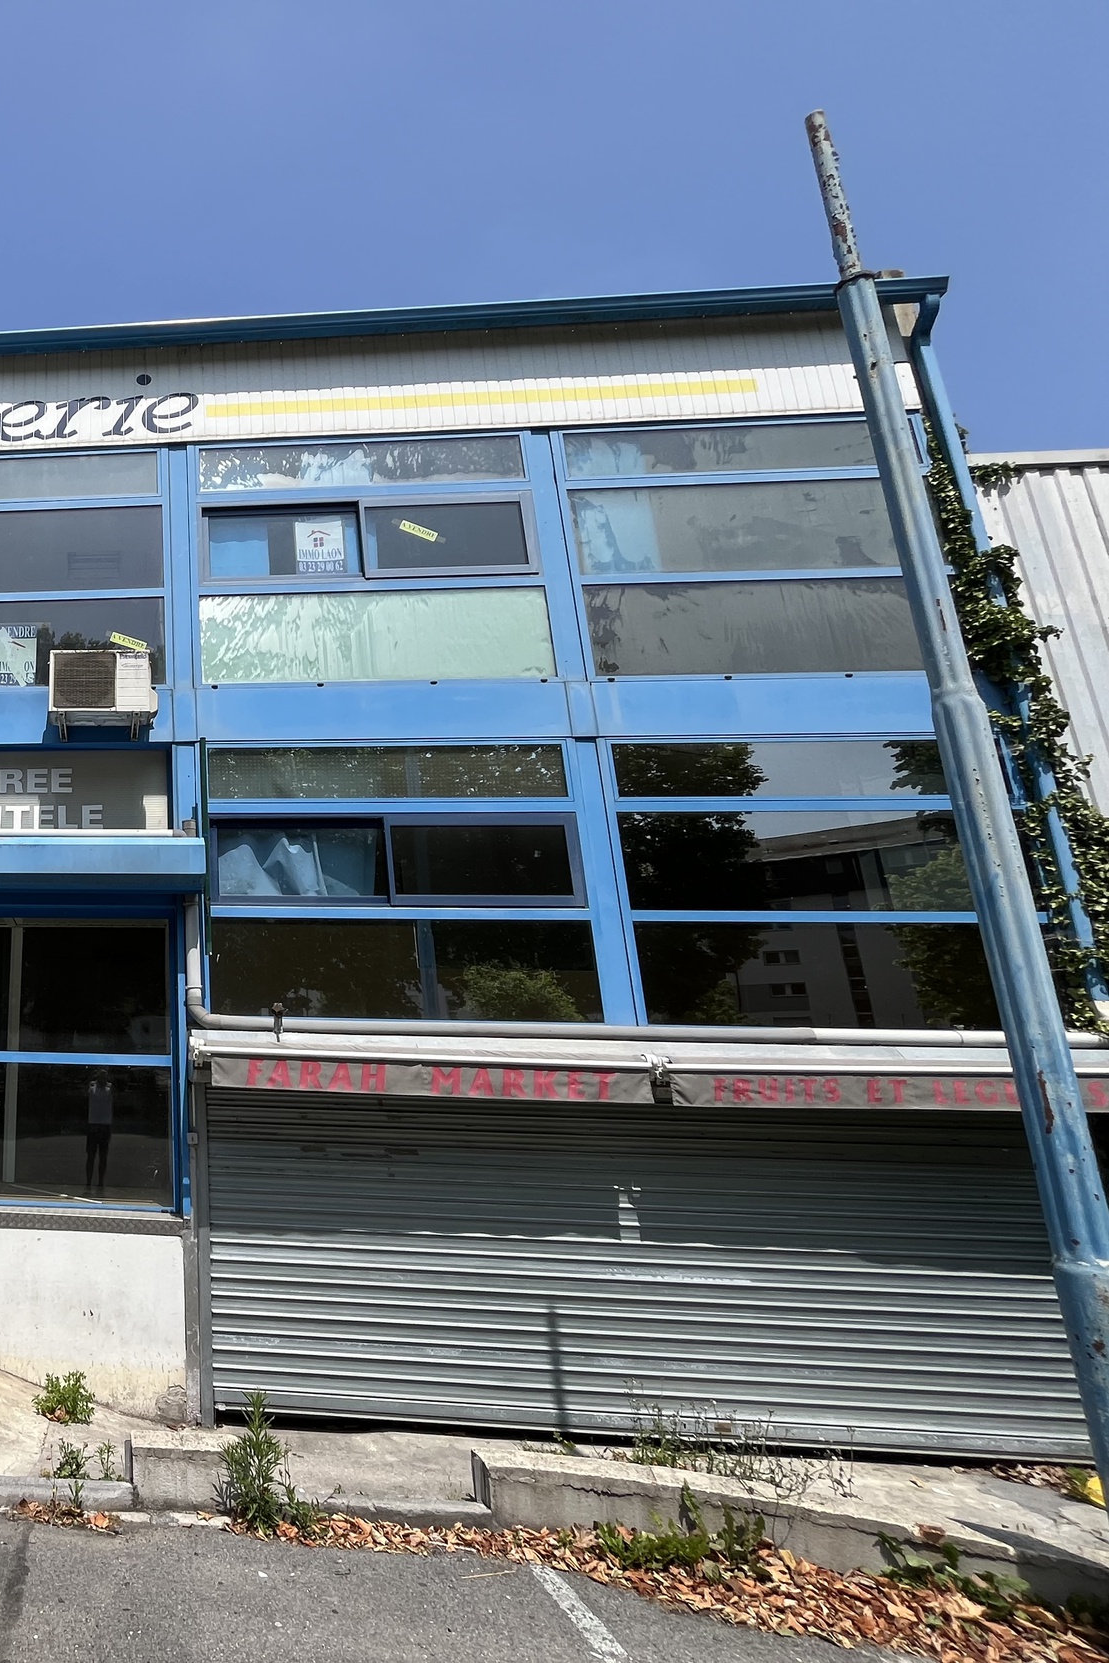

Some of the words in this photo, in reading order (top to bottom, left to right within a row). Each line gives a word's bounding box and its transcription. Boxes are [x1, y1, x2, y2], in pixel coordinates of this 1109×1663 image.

[299, 549, 320, 560] IMMO
[322, 548, 343, 560] LAON
[298, 561, 307, 572] 03
[308, 561, 316, 572] 23
[317, 561, 325, 572] 29
[335, 560, 343, 571] 62
[4, 625, 36, 638] ENDRE
[0, 673, 8, 684] 23
[246, 1058, 387, 1093] FARAH
[431, 1066, 618, 1100] MARKET
[713, 1076, 842, 1104] FRUITS
[867, 1079, 909, 1104] ET
